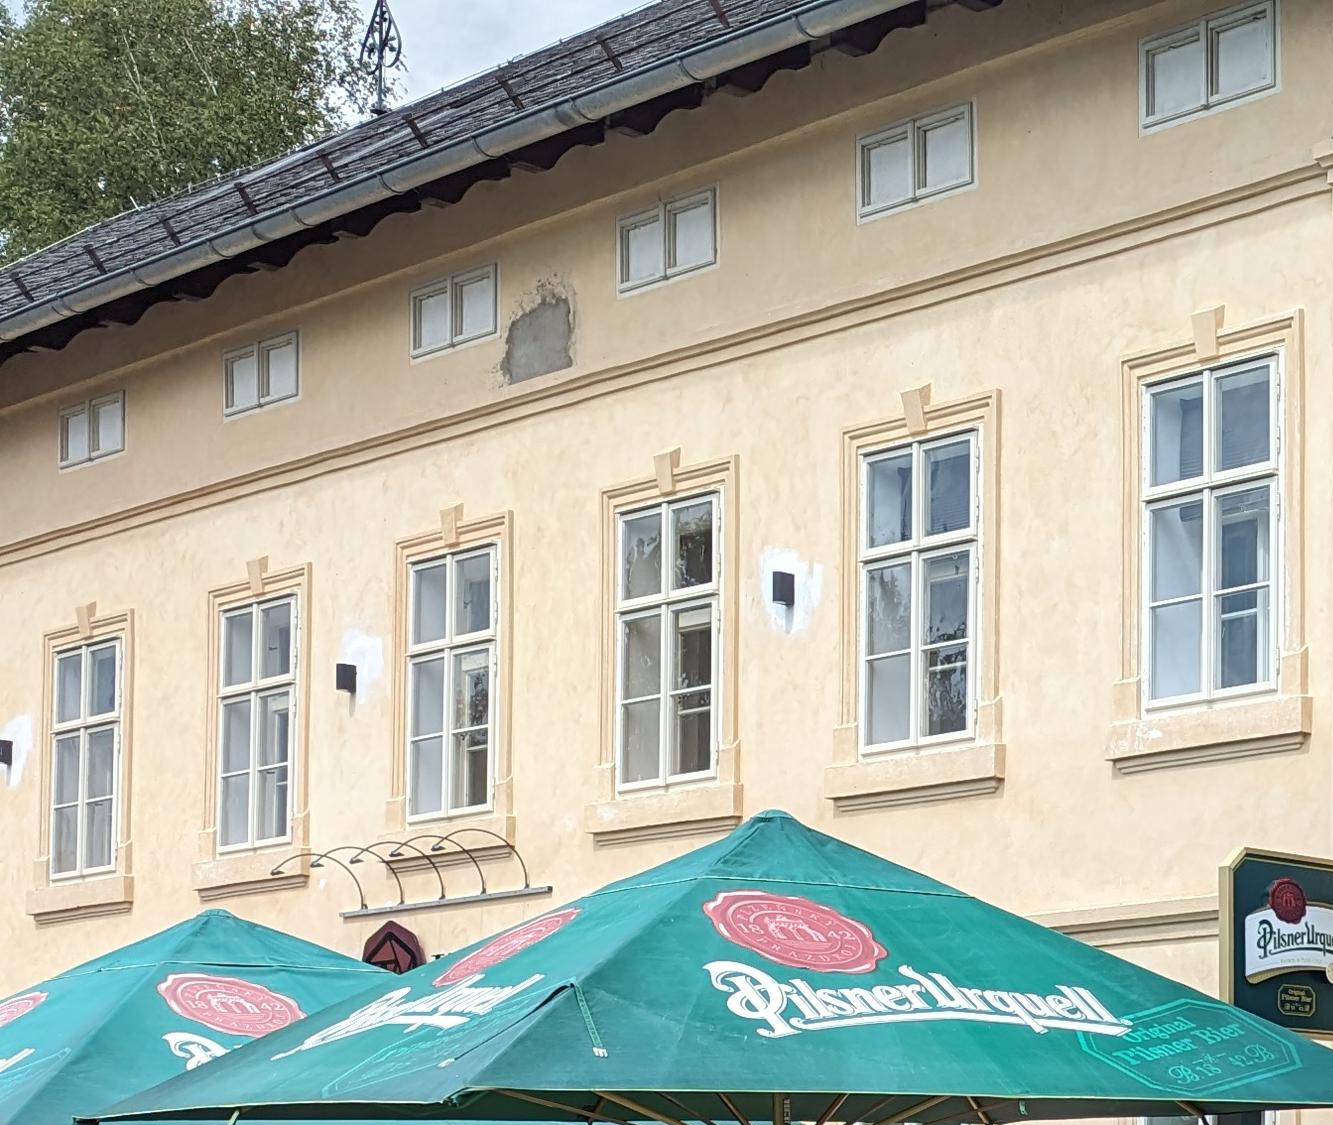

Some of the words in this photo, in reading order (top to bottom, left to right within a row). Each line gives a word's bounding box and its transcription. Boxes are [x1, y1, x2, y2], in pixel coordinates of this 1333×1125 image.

[1257, 919, 1307, 960] Pilsner
[702, 961, 933, 1039] Pilsner
[898, 965, 1124, 1035] Urquell
[1112, 1036, 1199, 1066] Pilsner
[1190, 1022, 1247, 1046] Bier
[1122, 1016, 1196, 1044] Original
